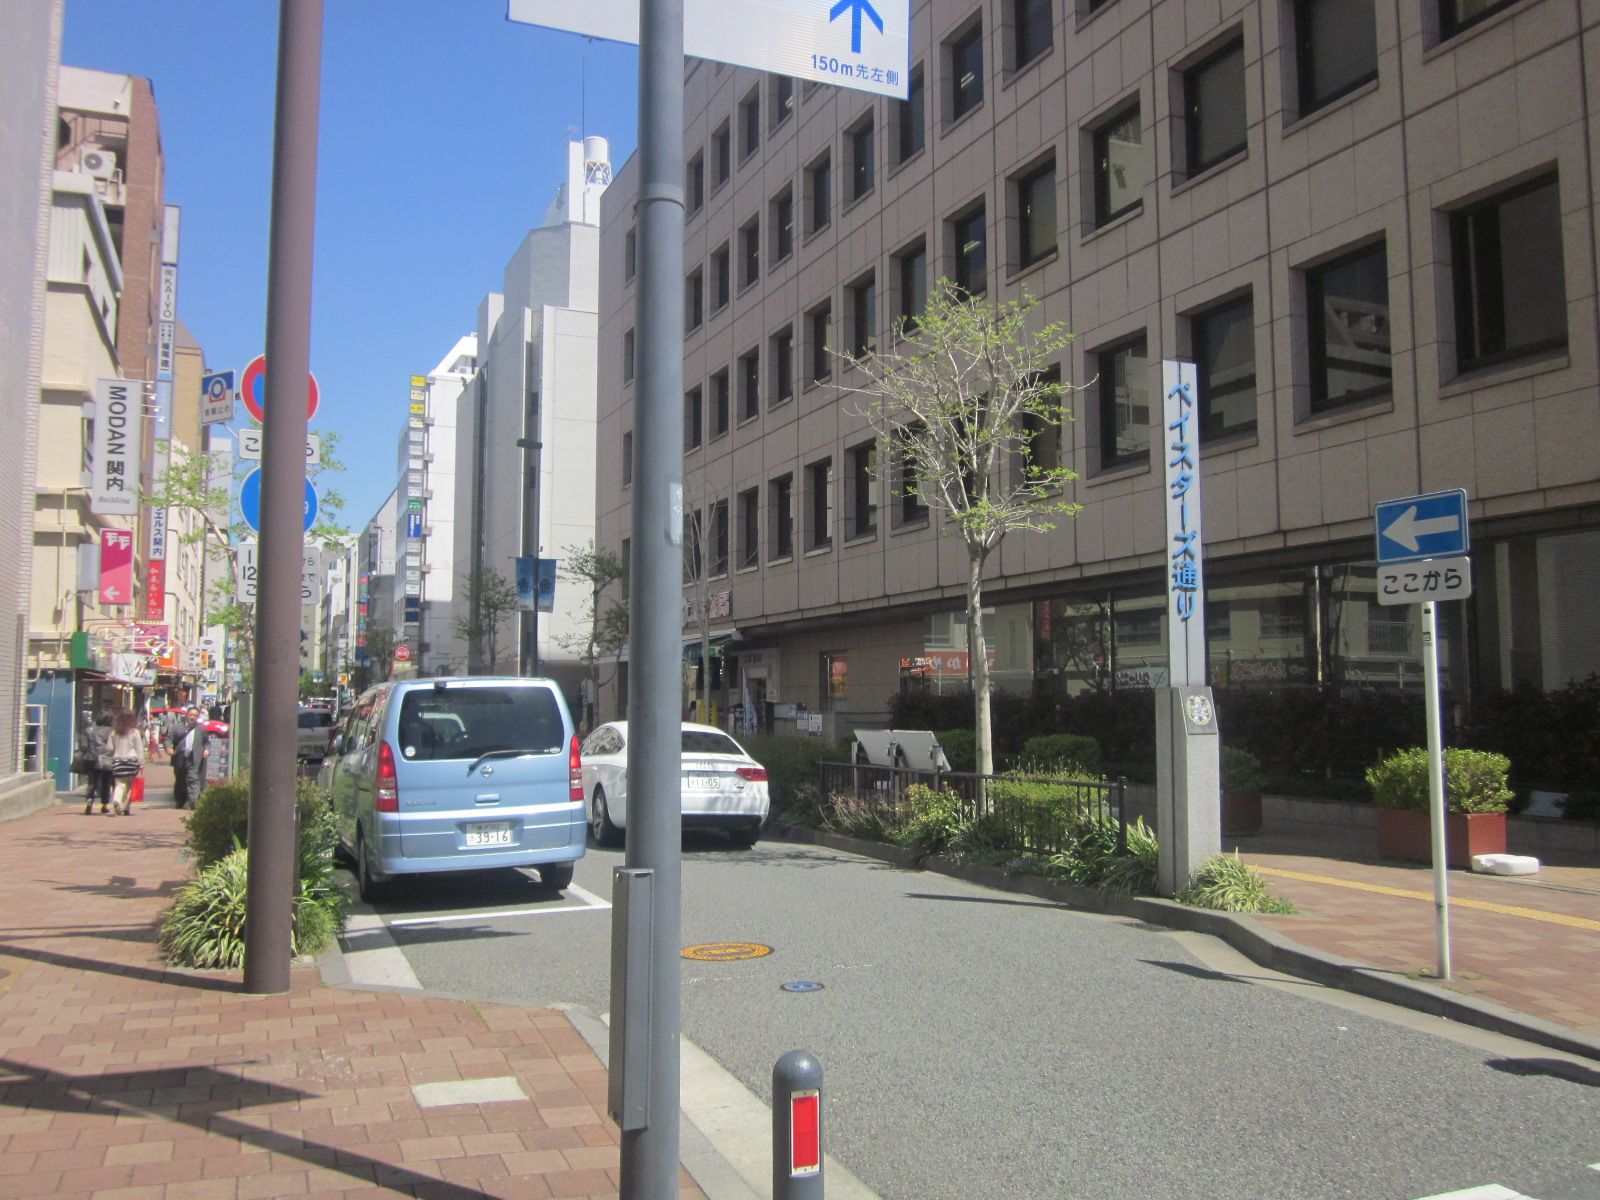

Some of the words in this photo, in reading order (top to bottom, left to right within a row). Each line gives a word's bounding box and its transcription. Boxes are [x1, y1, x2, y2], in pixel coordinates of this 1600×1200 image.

[811, 54, 899, 86] 150m先左側
[107, 386, 128, 455] MODAN
[1168, 383, 1199, 621] ベイスターズ通り
[1383, 568, 1463, 595] ここから
[476, 831, 509, 844] 39-16
